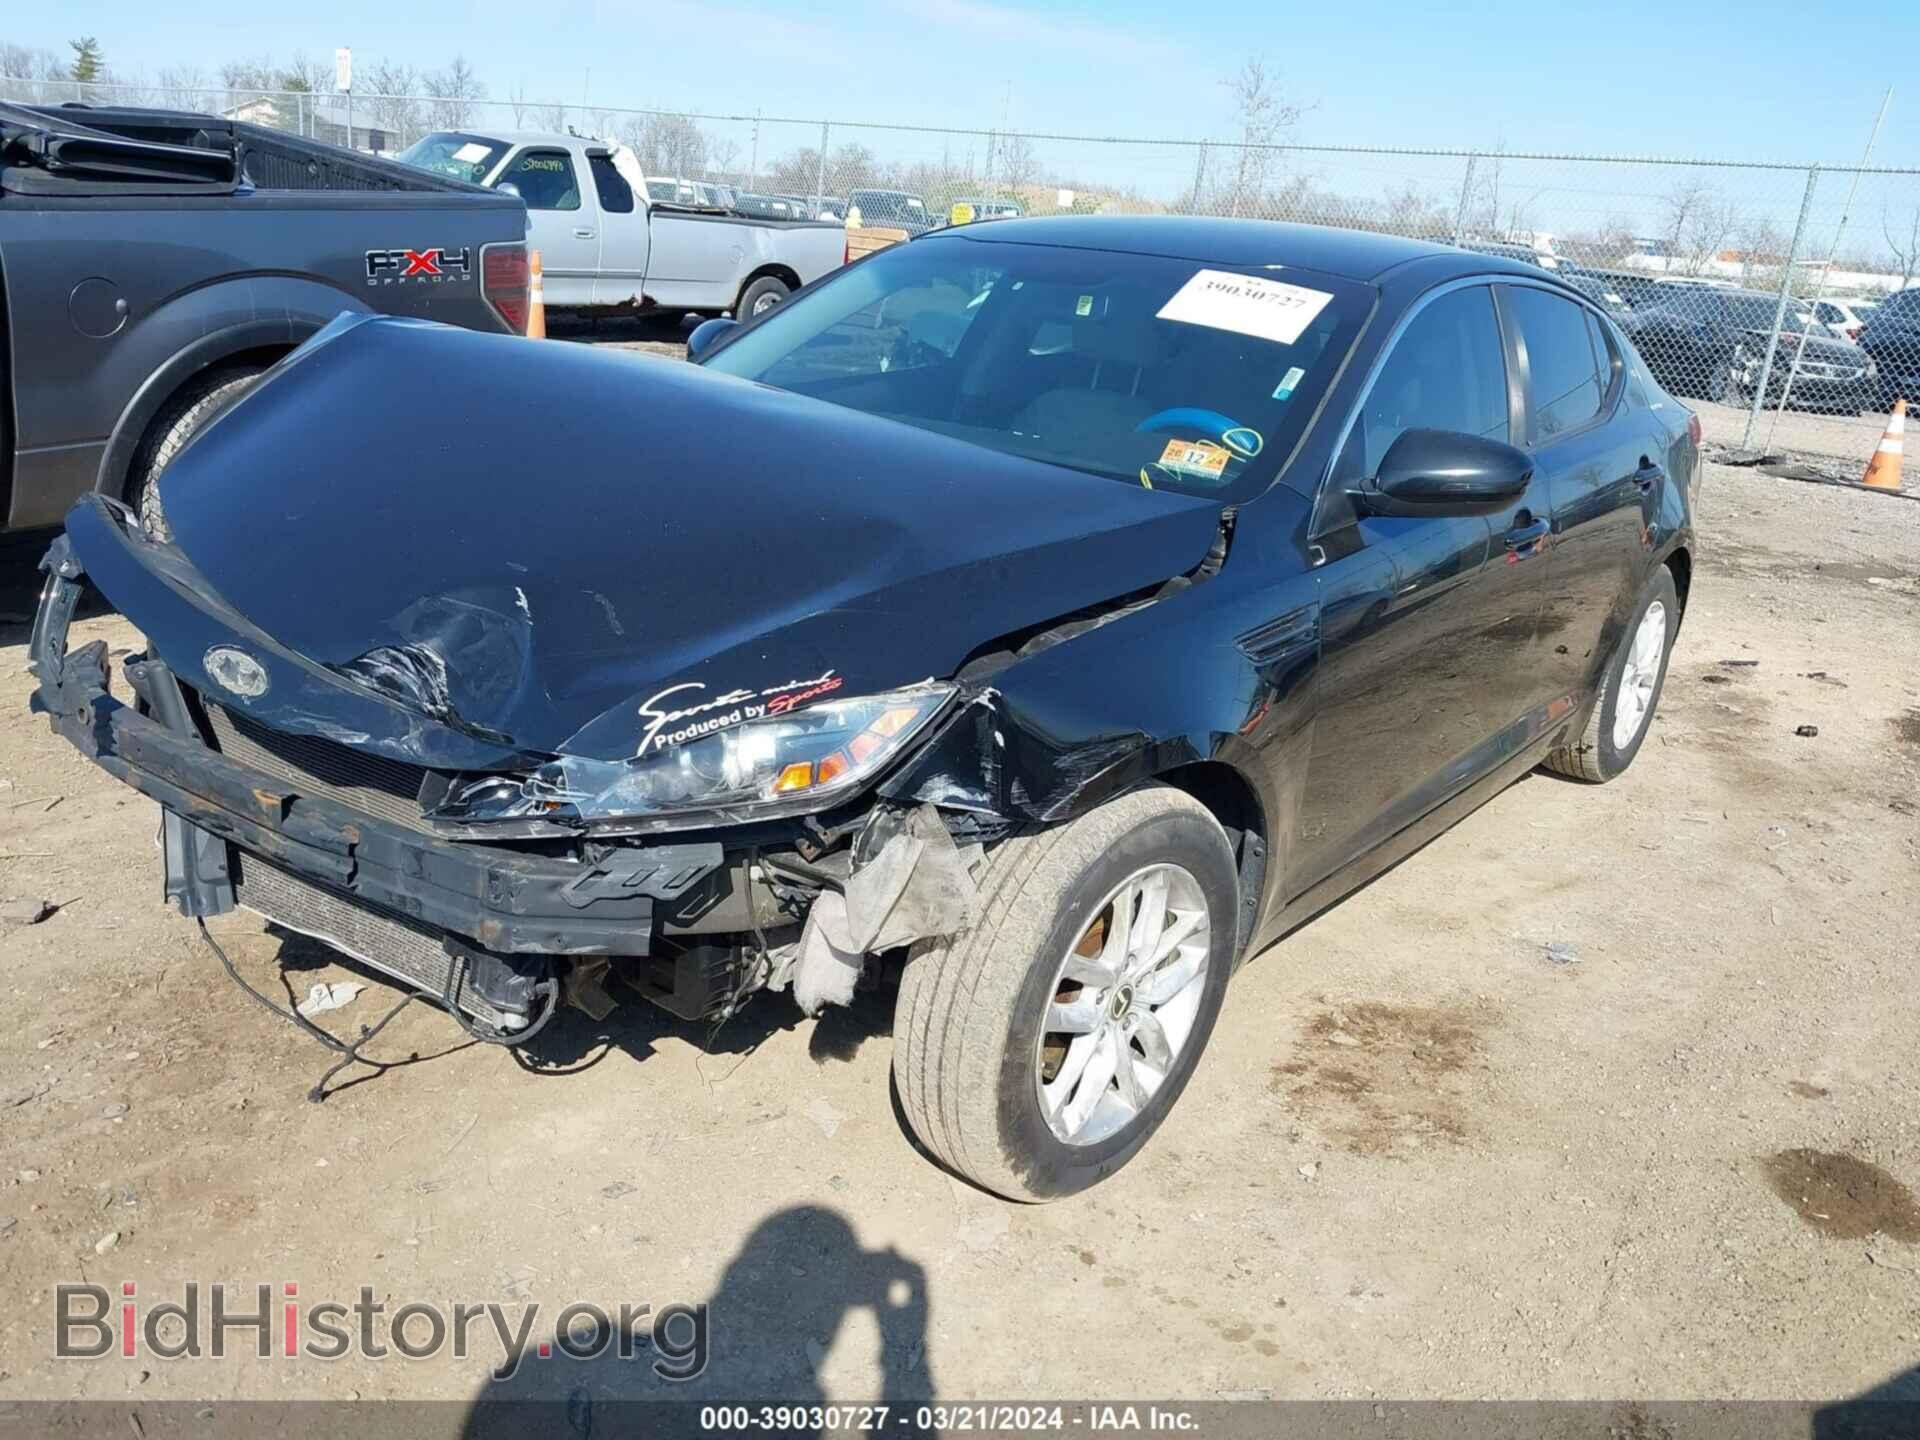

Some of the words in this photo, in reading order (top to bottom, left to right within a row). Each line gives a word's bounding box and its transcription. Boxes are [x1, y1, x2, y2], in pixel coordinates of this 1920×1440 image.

[366, 247, 471, 278] FX4
[367, 278, 406, 286] OFF
[417, 274, 471, 284] ROAD
[1205, 279, 1308, 310] 39030727
[1186, 450, 1206, 465] 12
[654, 708, 742, 750] Produced
[744, 702, 767, 724] by
[767, 676, 845, 716] Sports
